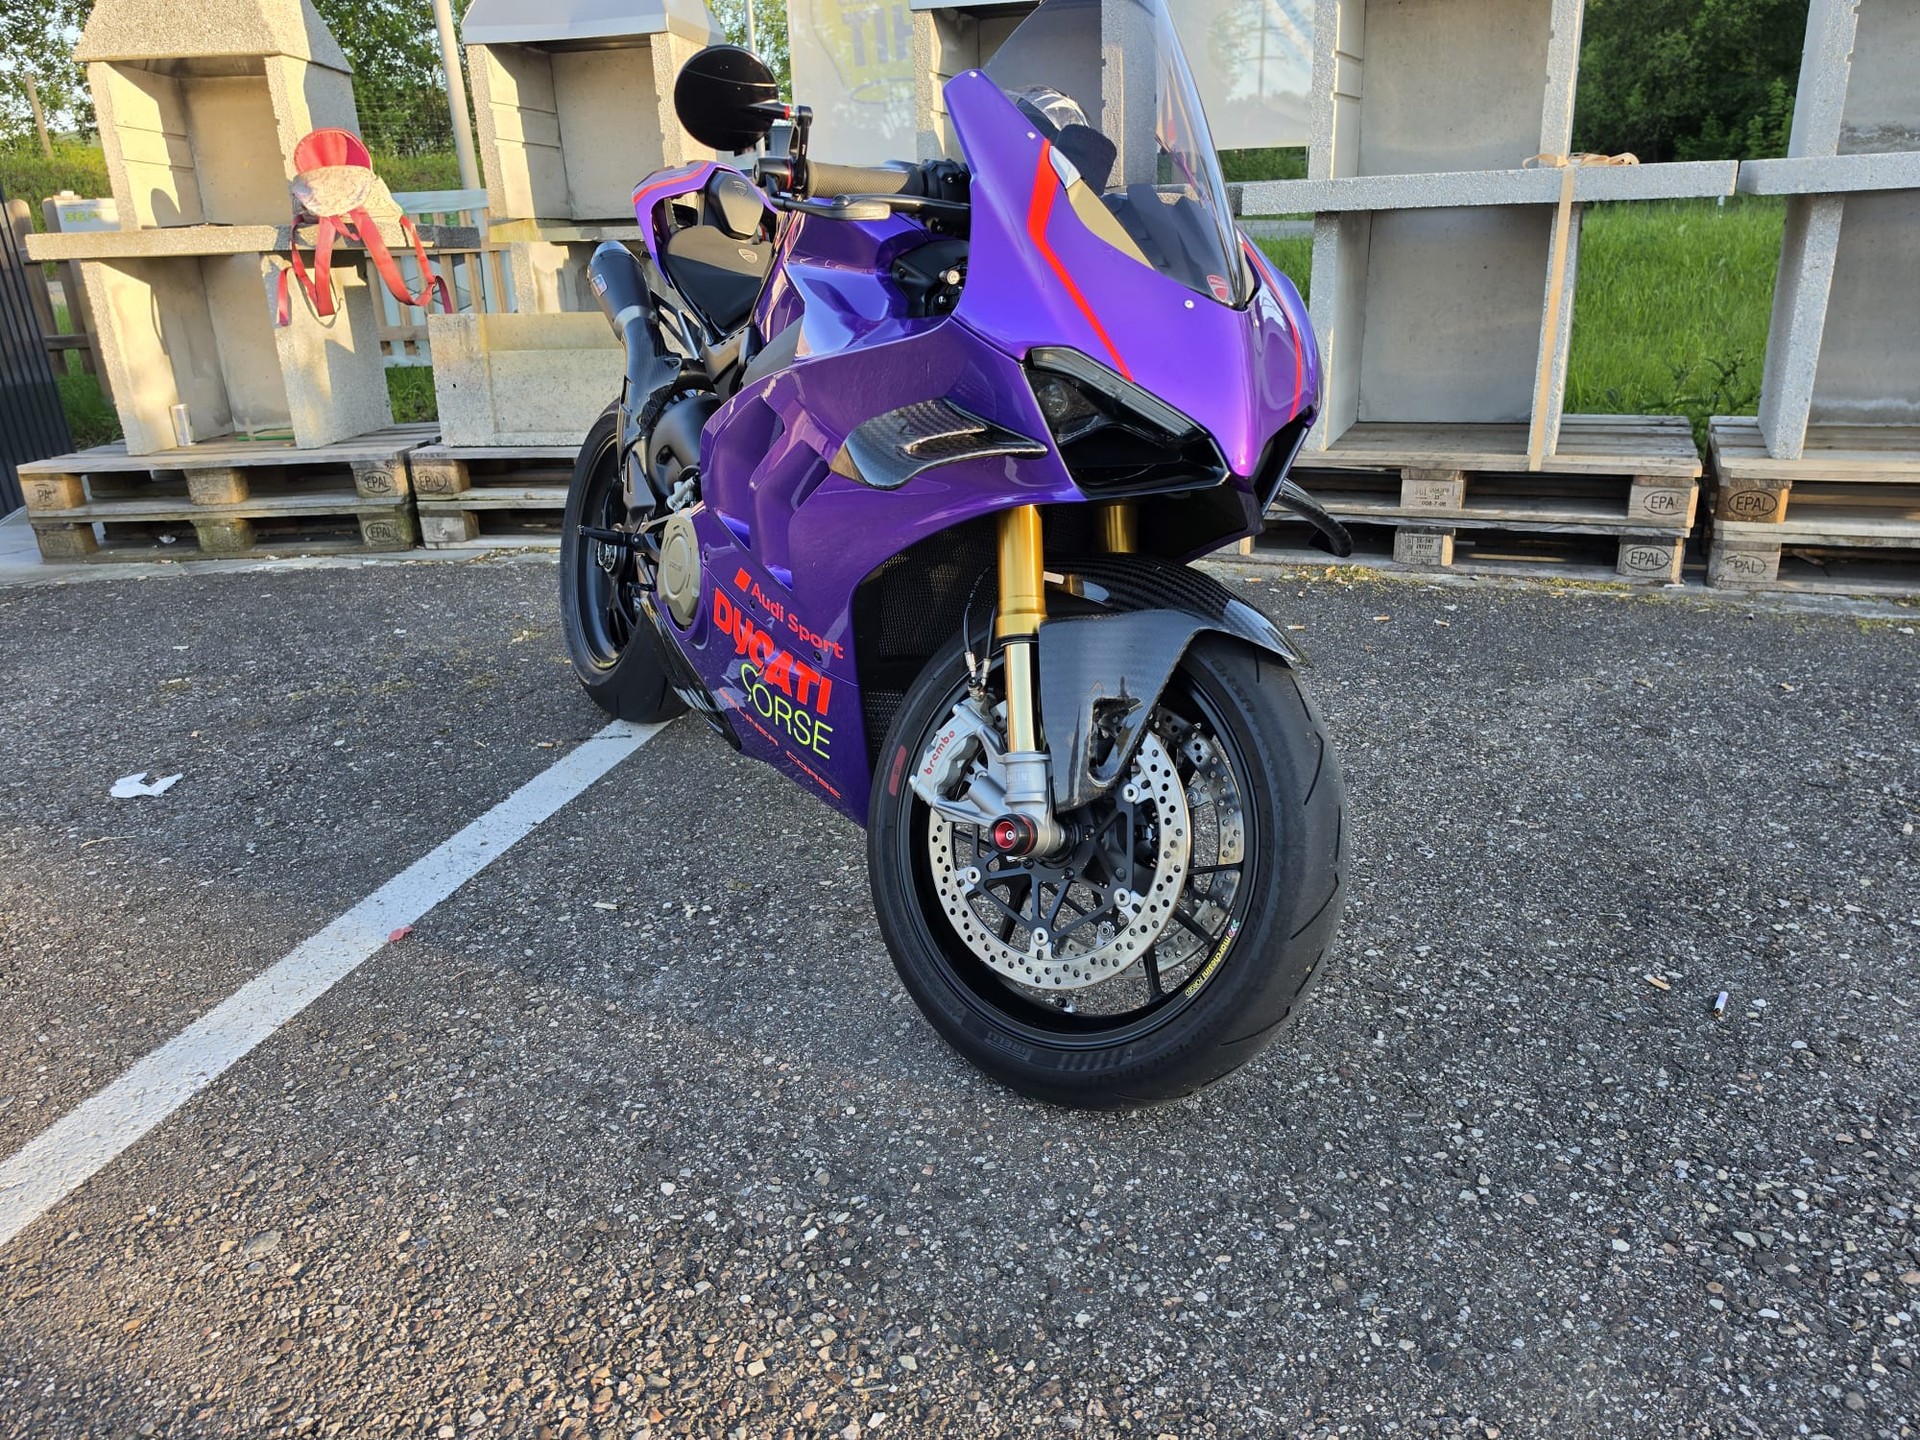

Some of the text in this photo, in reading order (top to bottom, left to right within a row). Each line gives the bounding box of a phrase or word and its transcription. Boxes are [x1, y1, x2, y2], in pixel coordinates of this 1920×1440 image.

[1735, 496, 1770, 512] EPAL
[1630, 551, 1664, 566] EPAL
[713, 587, 832, 716] DUCATI
[751, 582, 844, 660] Audi Sport
[741, 663, 833, 760] CORSE
[923, 730, 956, 775] brembo
